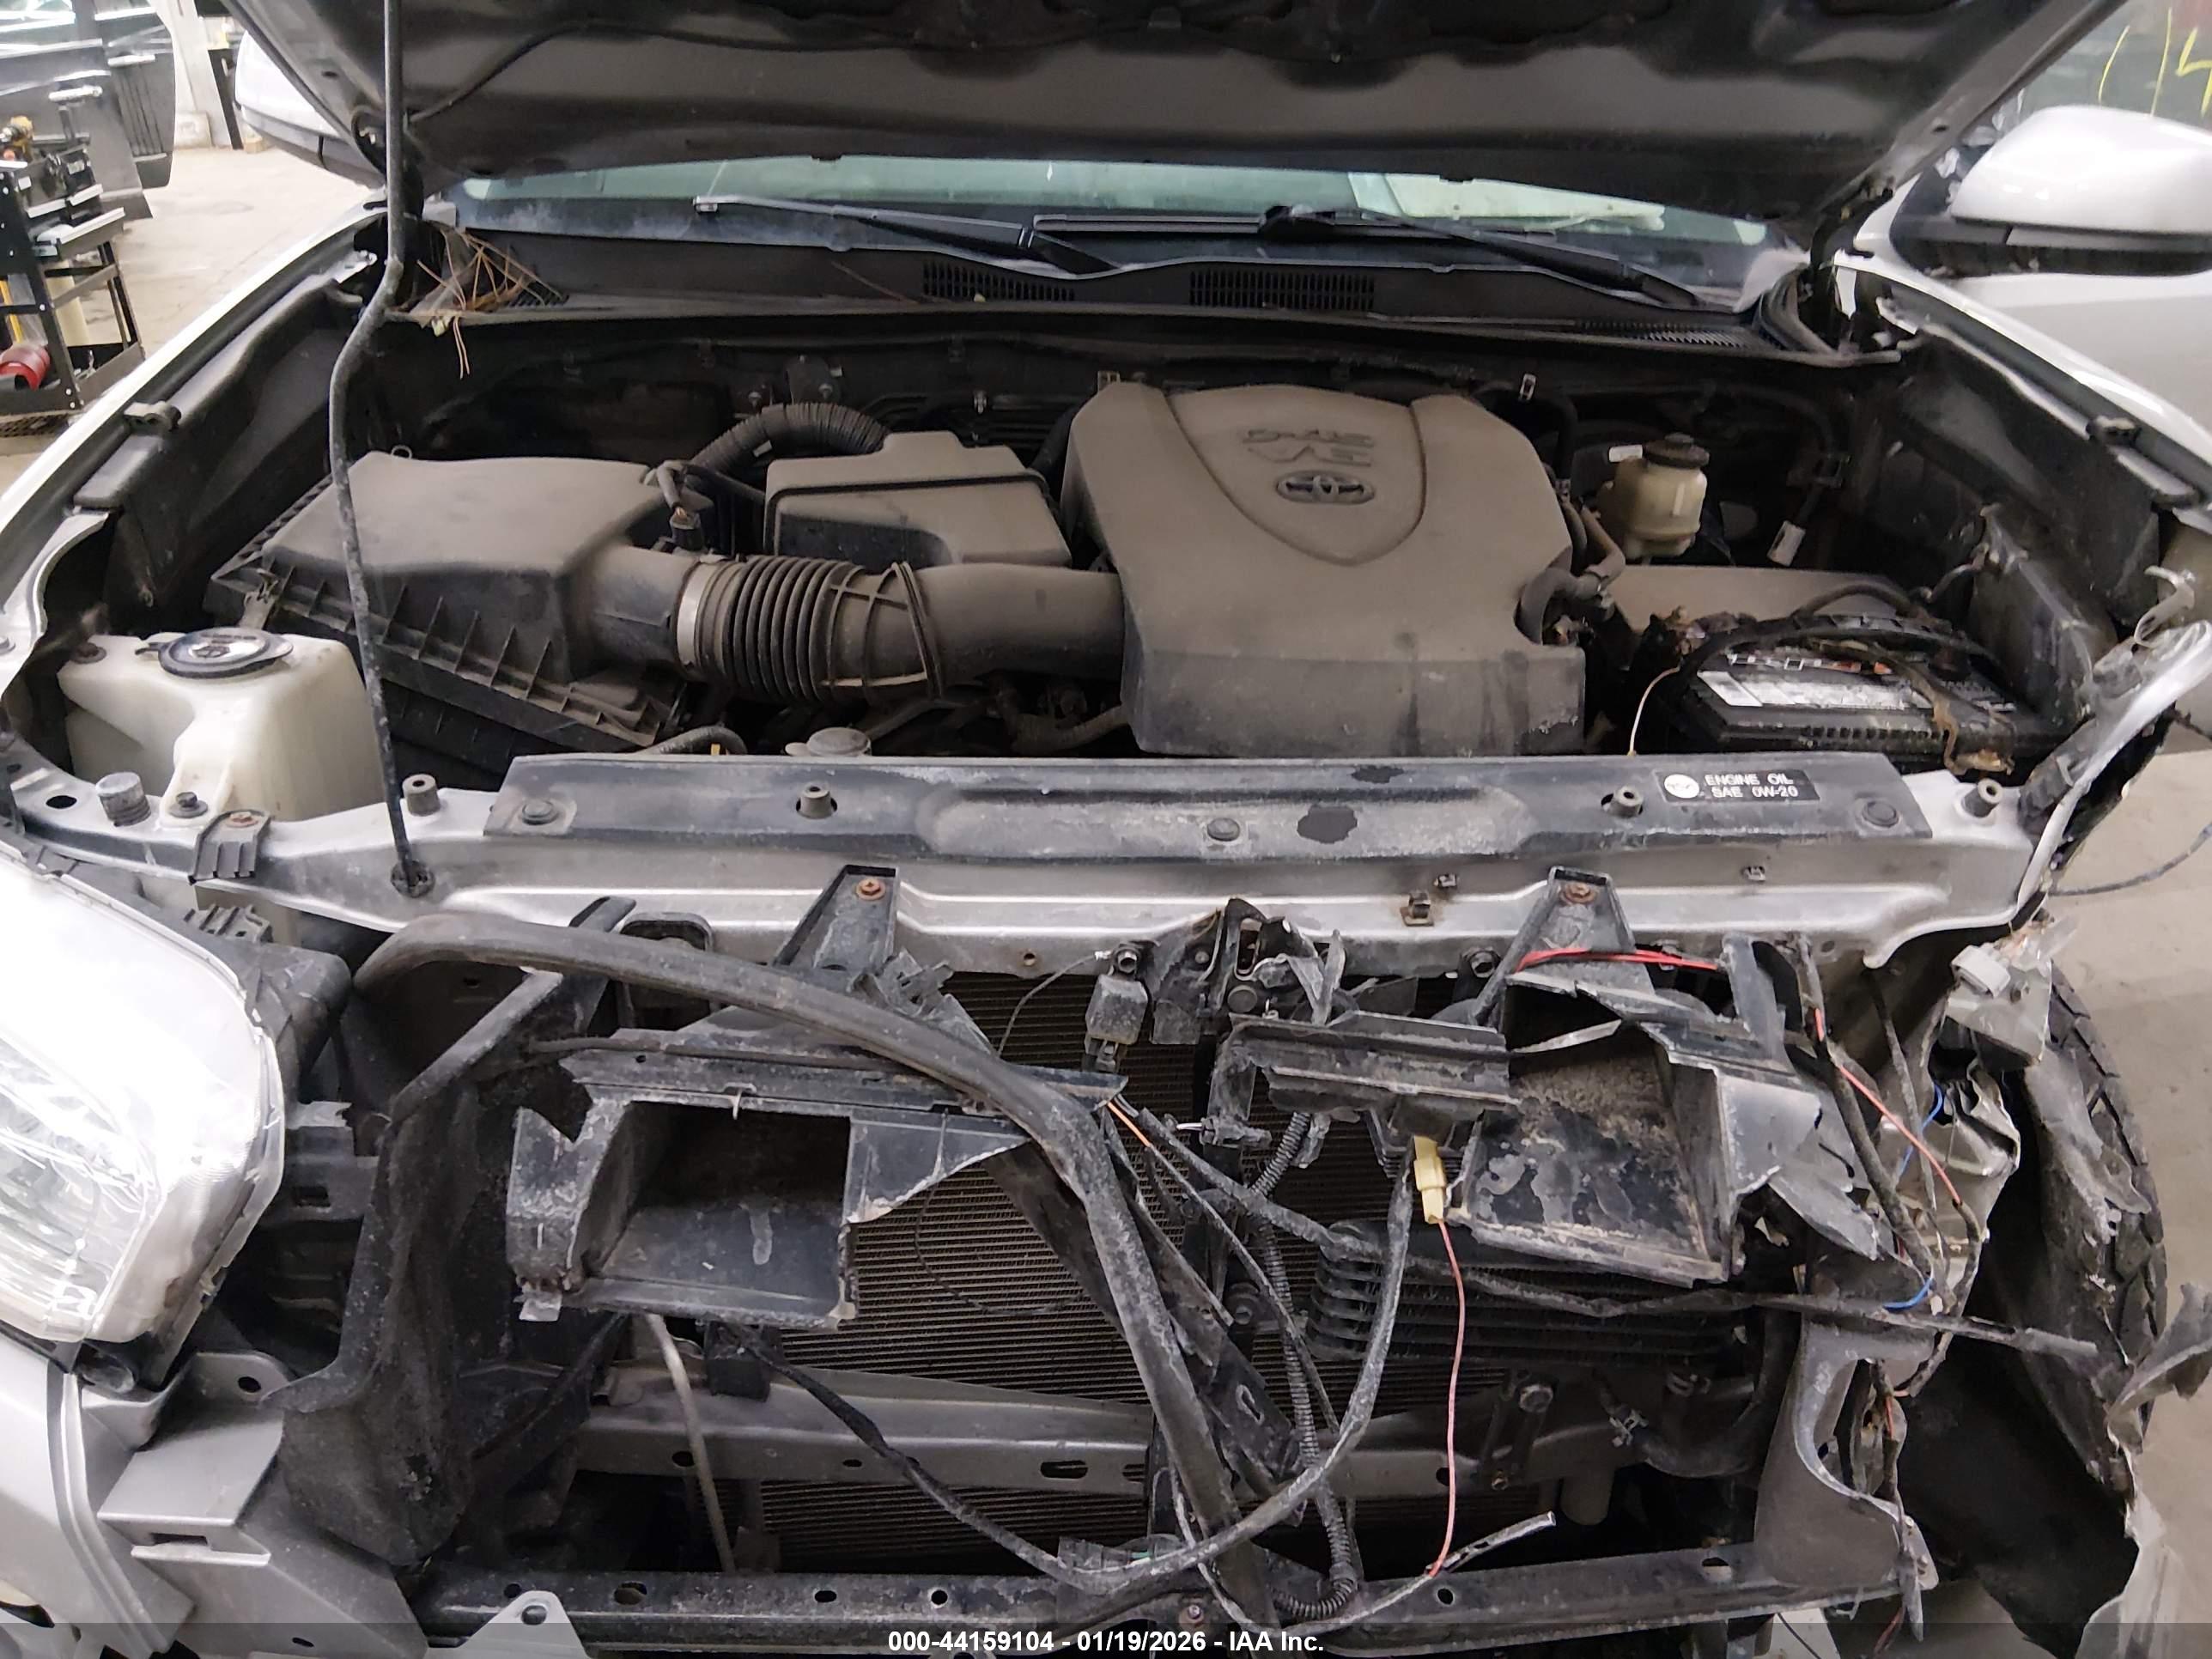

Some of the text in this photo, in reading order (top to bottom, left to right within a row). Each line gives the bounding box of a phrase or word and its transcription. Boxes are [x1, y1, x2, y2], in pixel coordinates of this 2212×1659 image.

[1704, 773, 1794, 786] ENGINE OIL
[1711, 786, 1799, 798] SAE 0W-20
